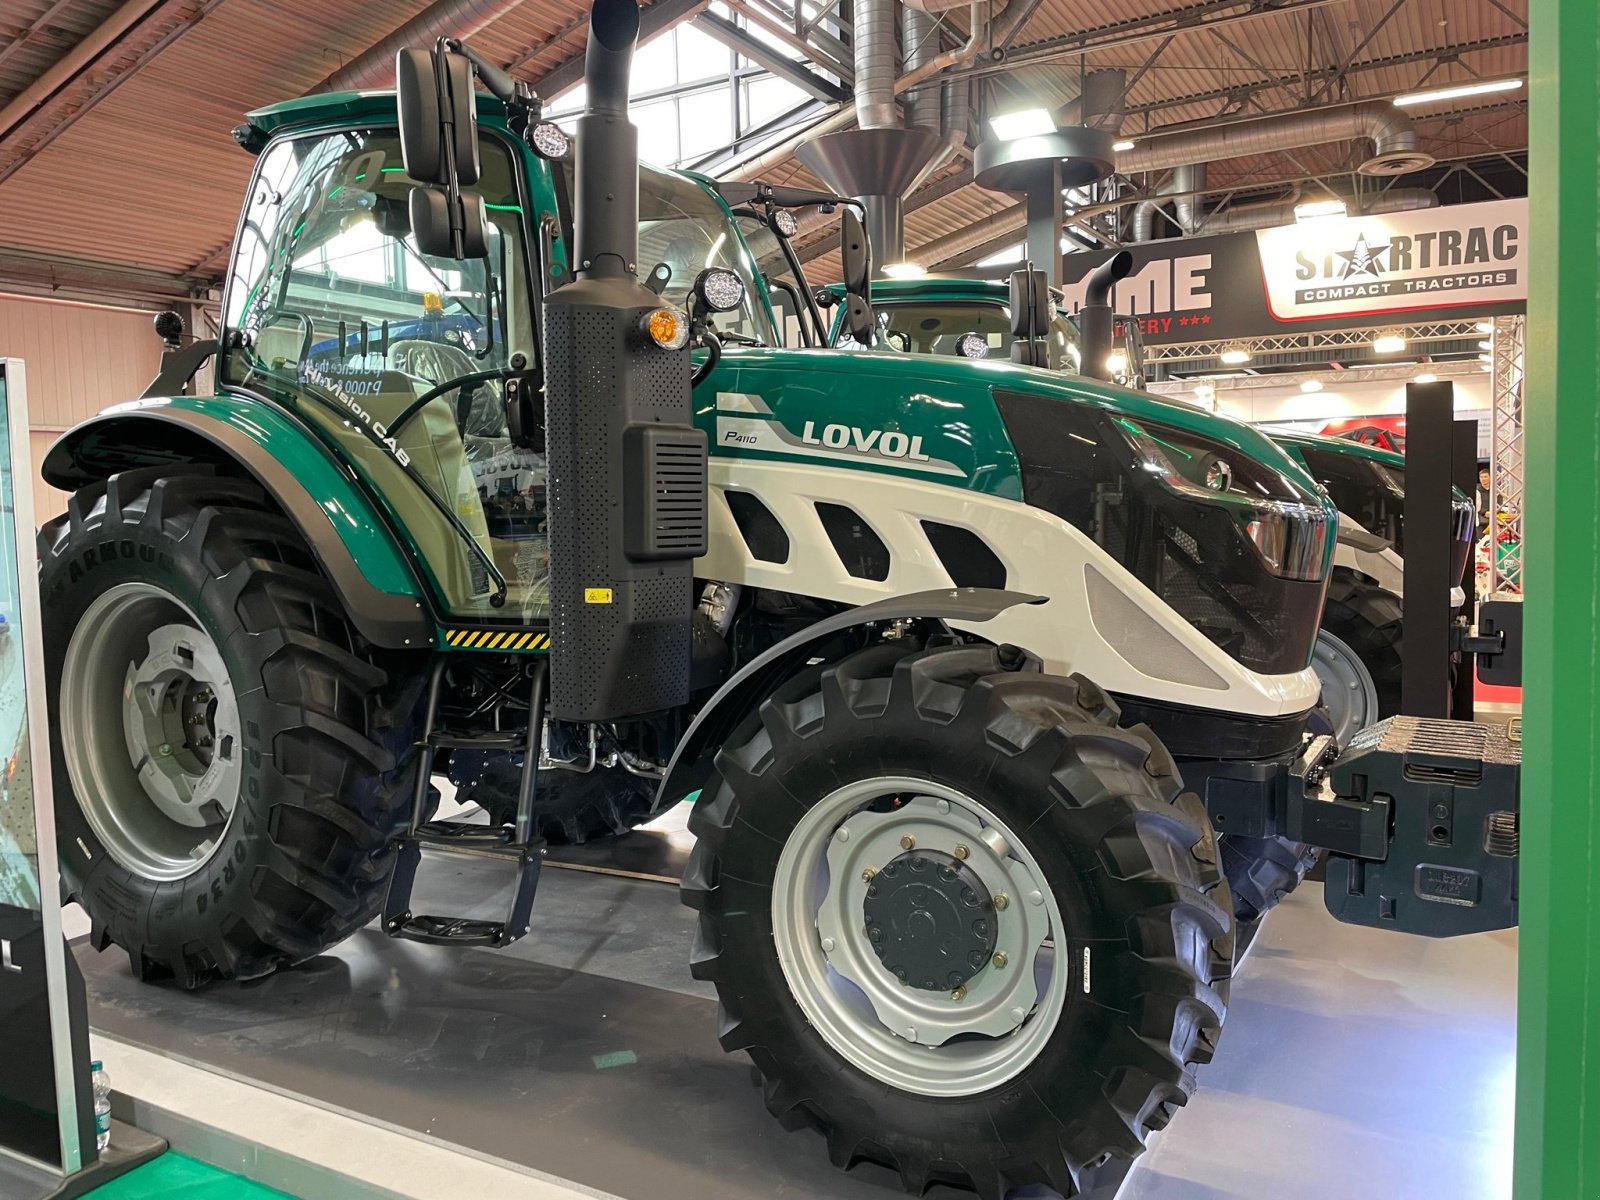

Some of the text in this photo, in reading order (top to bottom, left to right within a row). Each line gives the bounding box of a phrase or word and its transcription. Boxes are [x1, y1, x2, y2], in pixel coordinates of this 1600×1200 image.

[1295, 224, 1519, 281] STARTRAC
[1303, 272, 1507, 301] COMPACT TRACTORS
[325, 377, 371, 424] Vision
[372, 421, 411, 467] CAB
[724, 431, 758, 444] P4110
[802, 420, 930, 462] LOVOL
